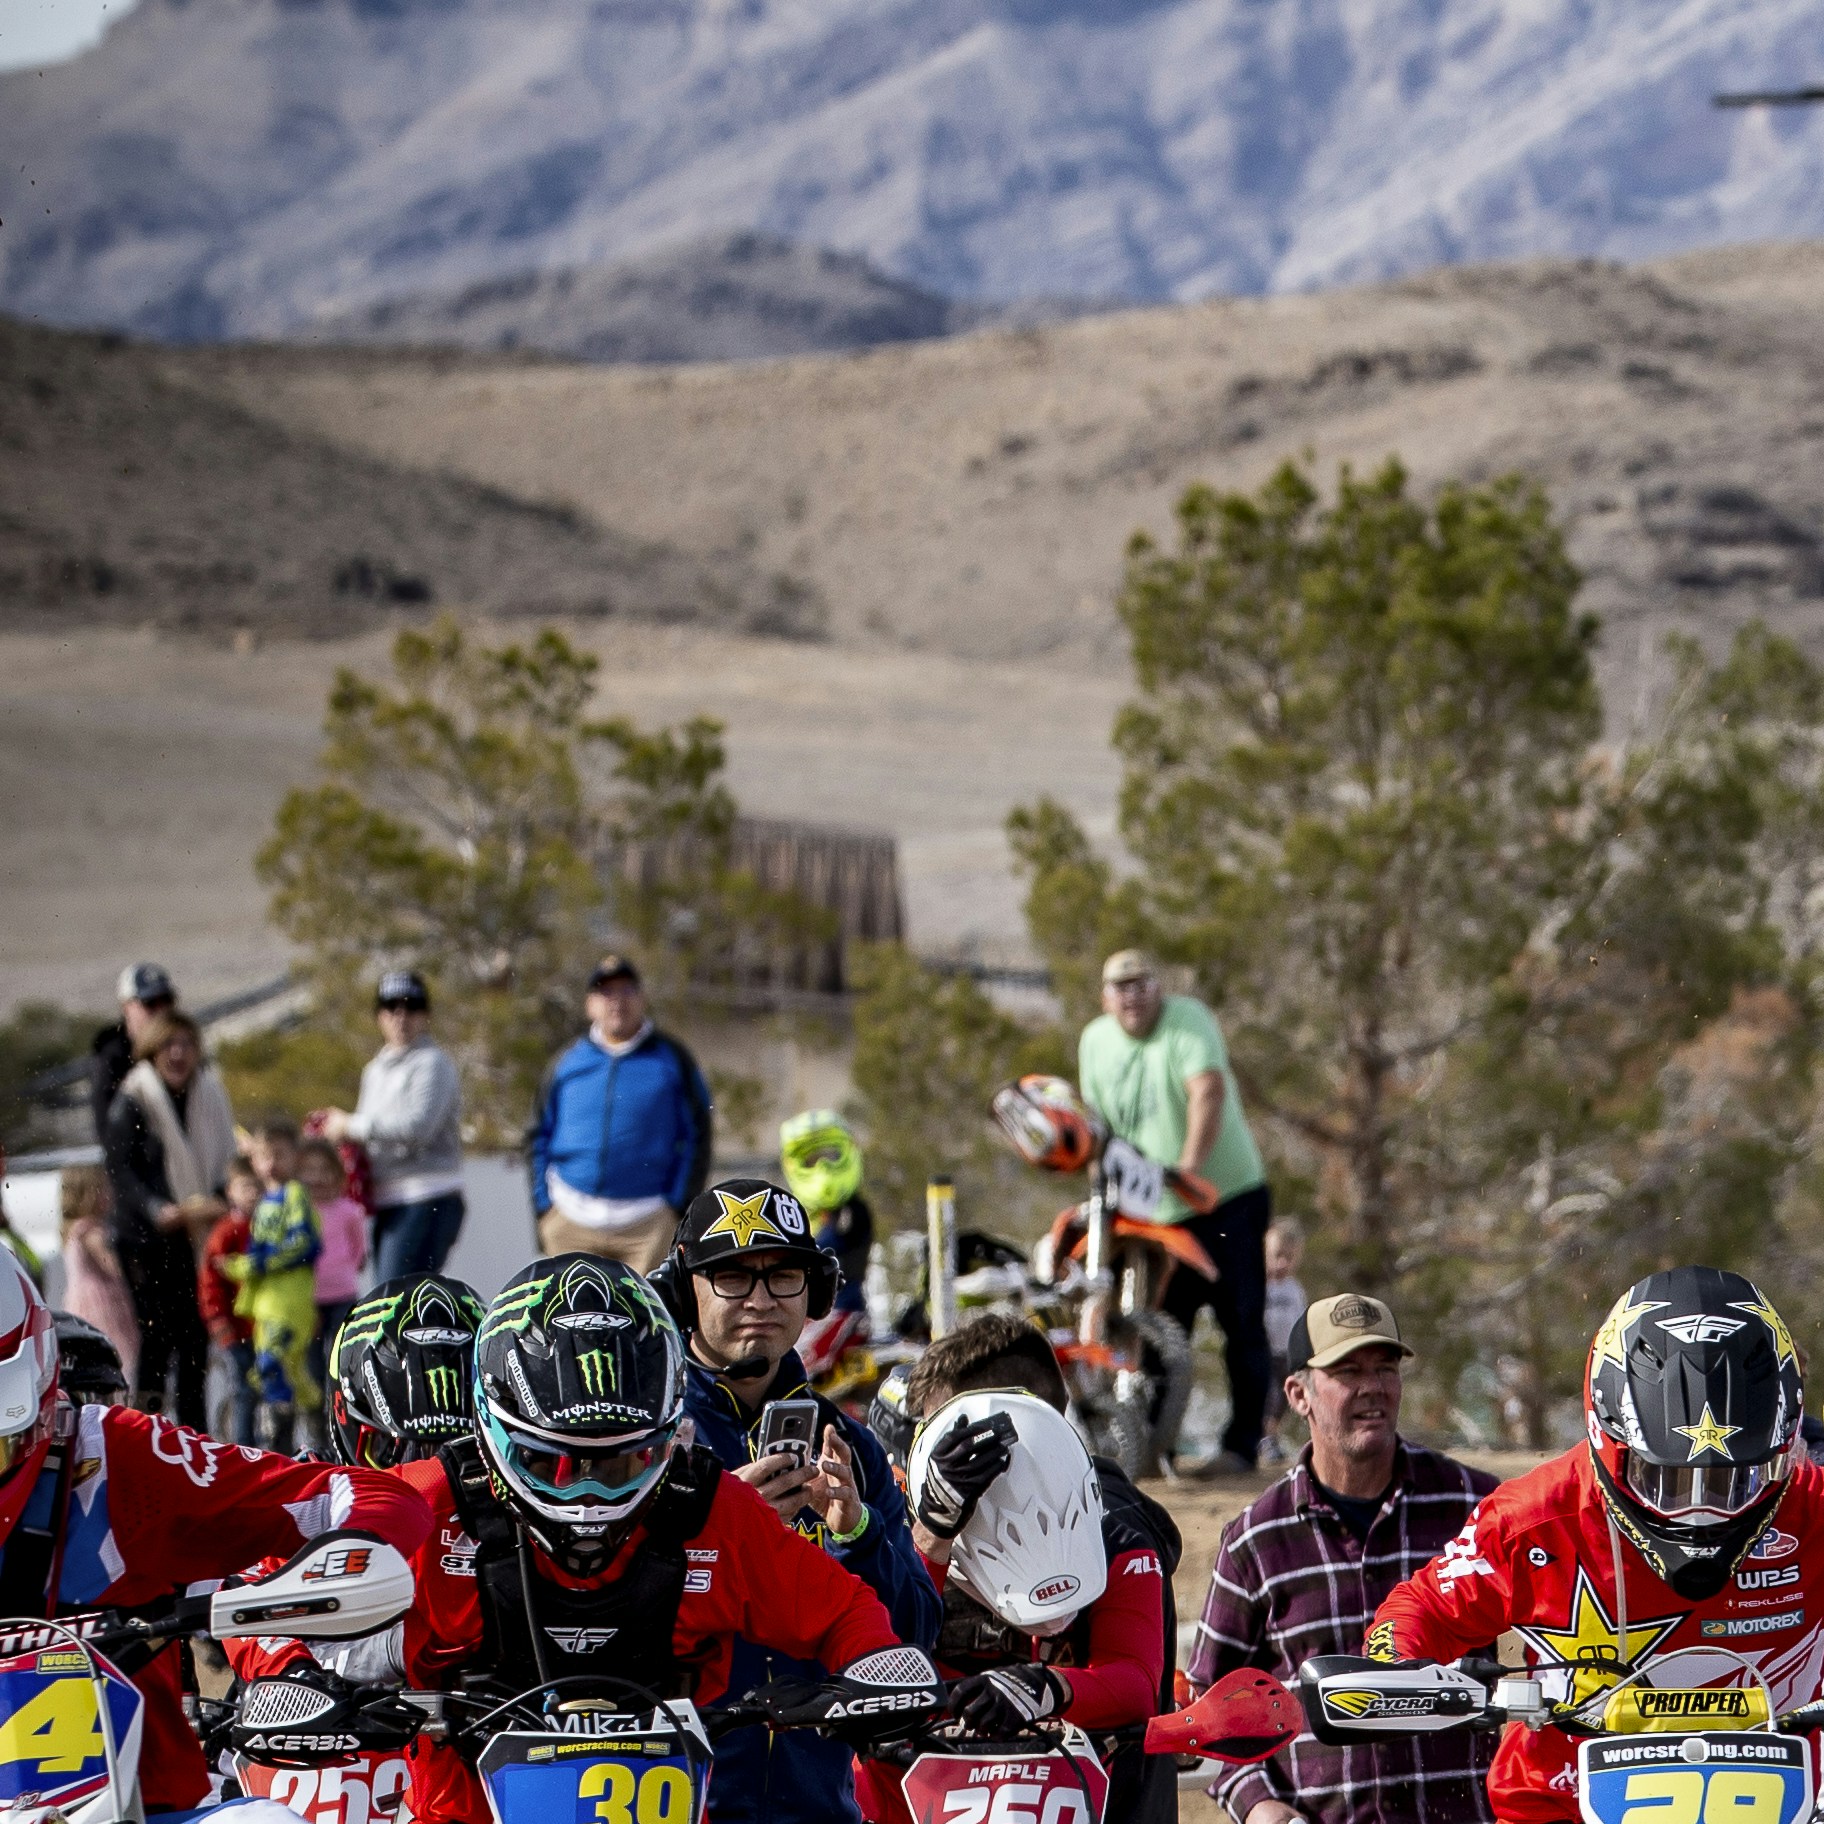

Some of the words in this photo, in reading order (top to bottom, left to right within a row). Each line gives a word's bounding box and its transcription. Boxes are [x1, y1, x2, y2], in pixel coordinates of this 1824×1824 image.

[552, 1402, 652, 1420] MONSTER
[569, 1416, 640, 1424] ENERGY
[1737, 1565, 1800, 1591] WPS
[1036, 1579, 1075, 1602] BELL
[1738, 1593, 1804, 1609] REKLUSE
[1727, 1611, 1802, 1636] MOTOREX
[825, 1691, 937, 1719] ACERBIS
[1368, 1698, 1435, 1711] CYCRA
[1642, 1691, 1744, 1714] PROTAPER
[0, 1678, 108, 1773] 4
[245, 1733, 362, 1751] ACERBIS
[557, 1741, 642, 1754] worcsracing.com
[1602, 1743, 1788, 1764] worcsraing.com
[968, 1763, 1061, 1784] MAPLE
